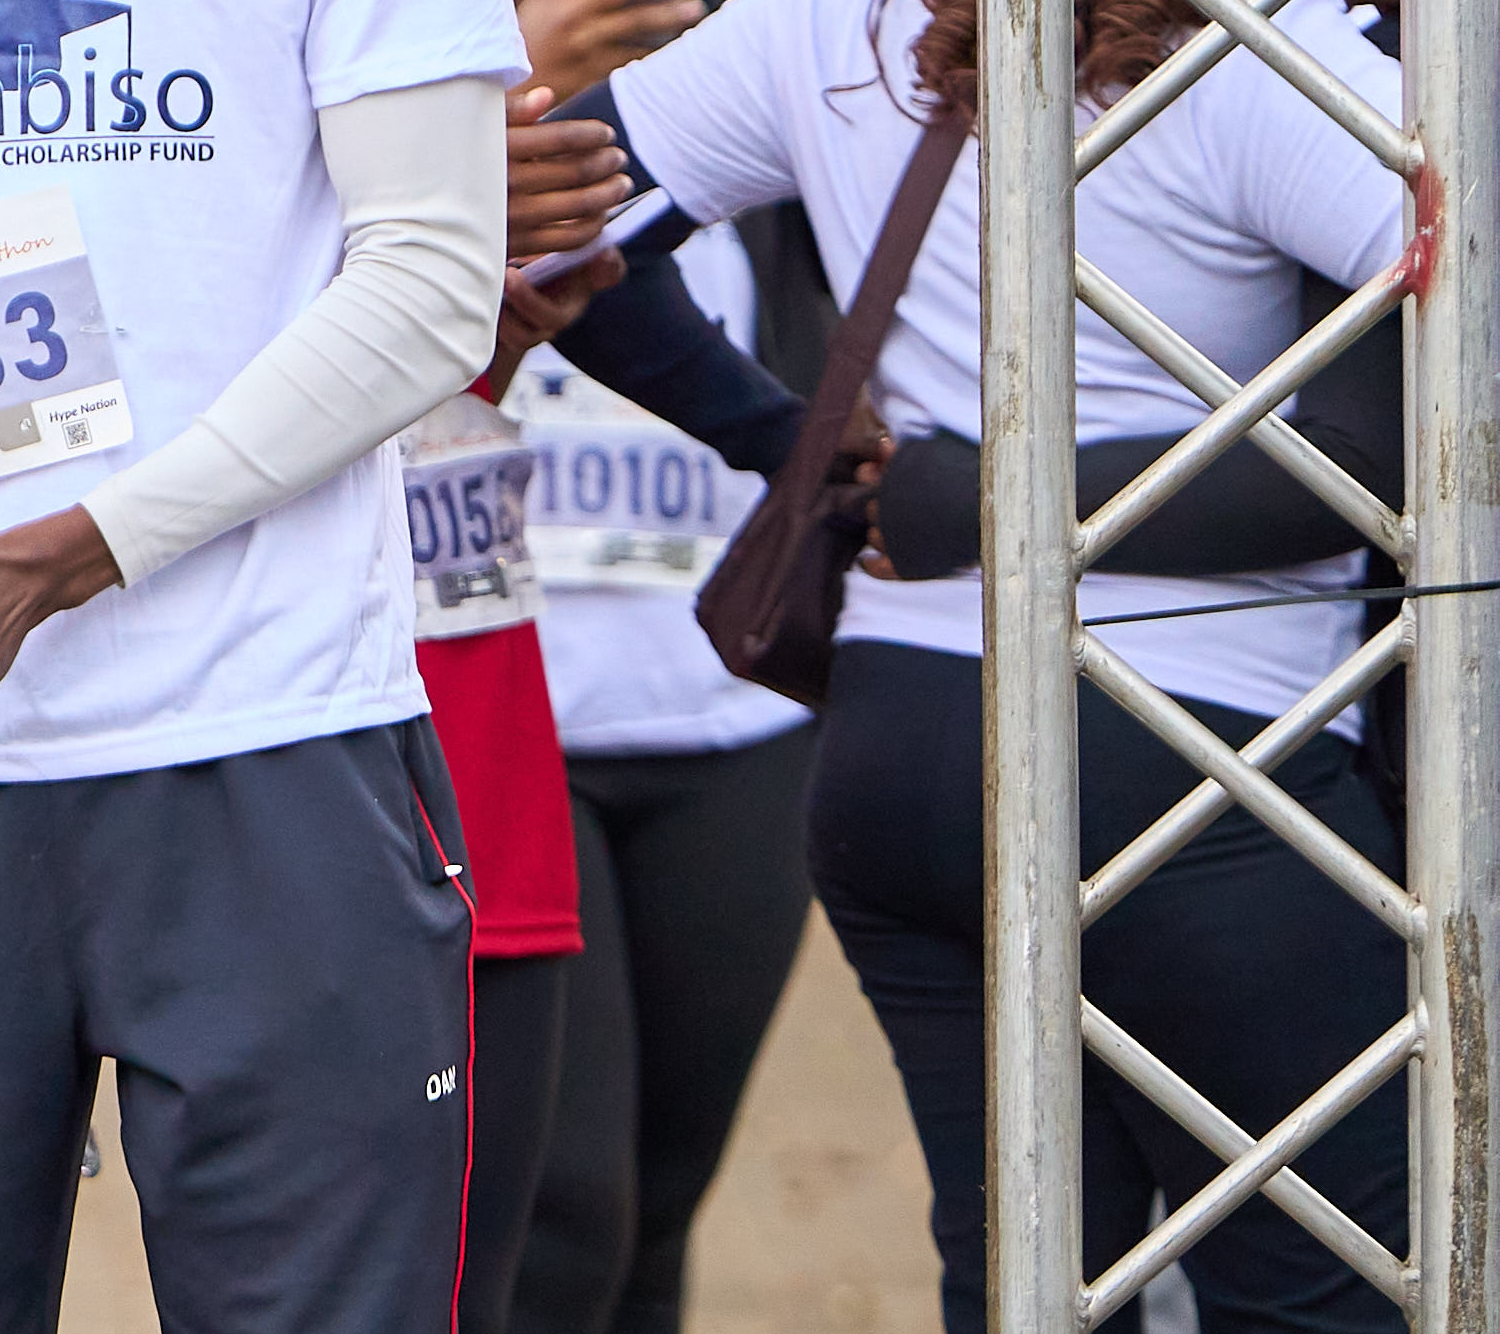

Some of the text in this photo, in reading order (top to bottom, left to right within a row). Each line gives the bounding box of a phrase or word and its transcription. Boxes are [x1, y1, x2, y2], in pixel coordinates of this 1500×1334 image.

[150, 142, 214, 163] FUND
[49, 396, 118, 423] Hype Nation
[537, 439, 714, 521] 10101
